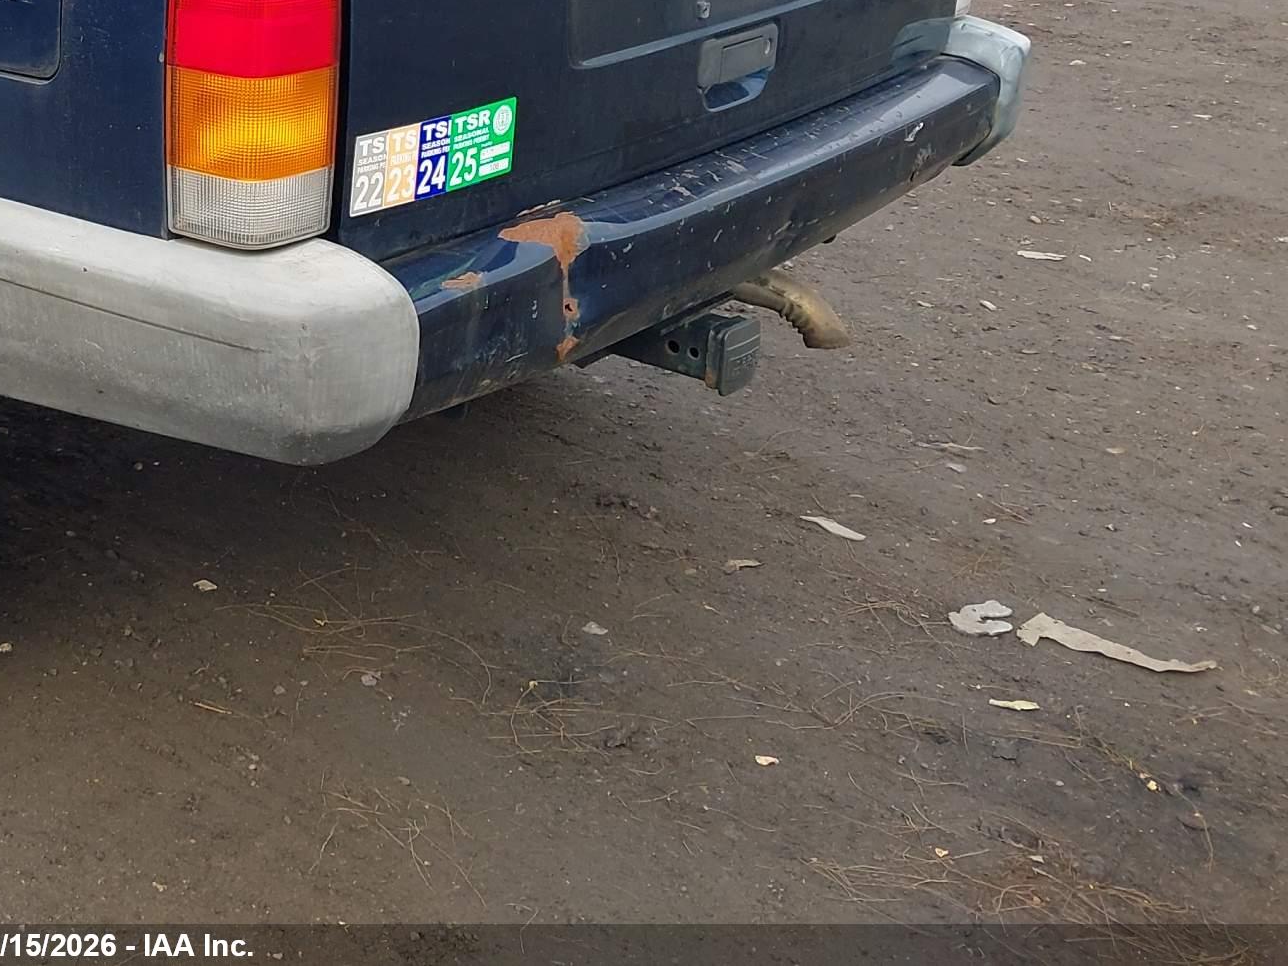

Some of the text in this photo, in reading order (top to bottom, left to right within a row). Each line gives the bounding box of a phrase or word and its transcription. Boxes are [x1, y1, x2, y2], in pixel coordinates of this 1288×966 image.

[454, 109, 491, 134] TSR
[359, 136, 387, 157] TS
[386, 165, 416, 203] 23
[417, 155, 446, 195] 24
[449, 147, 478, 187] 25
[353, 172, 384, 211] 22
